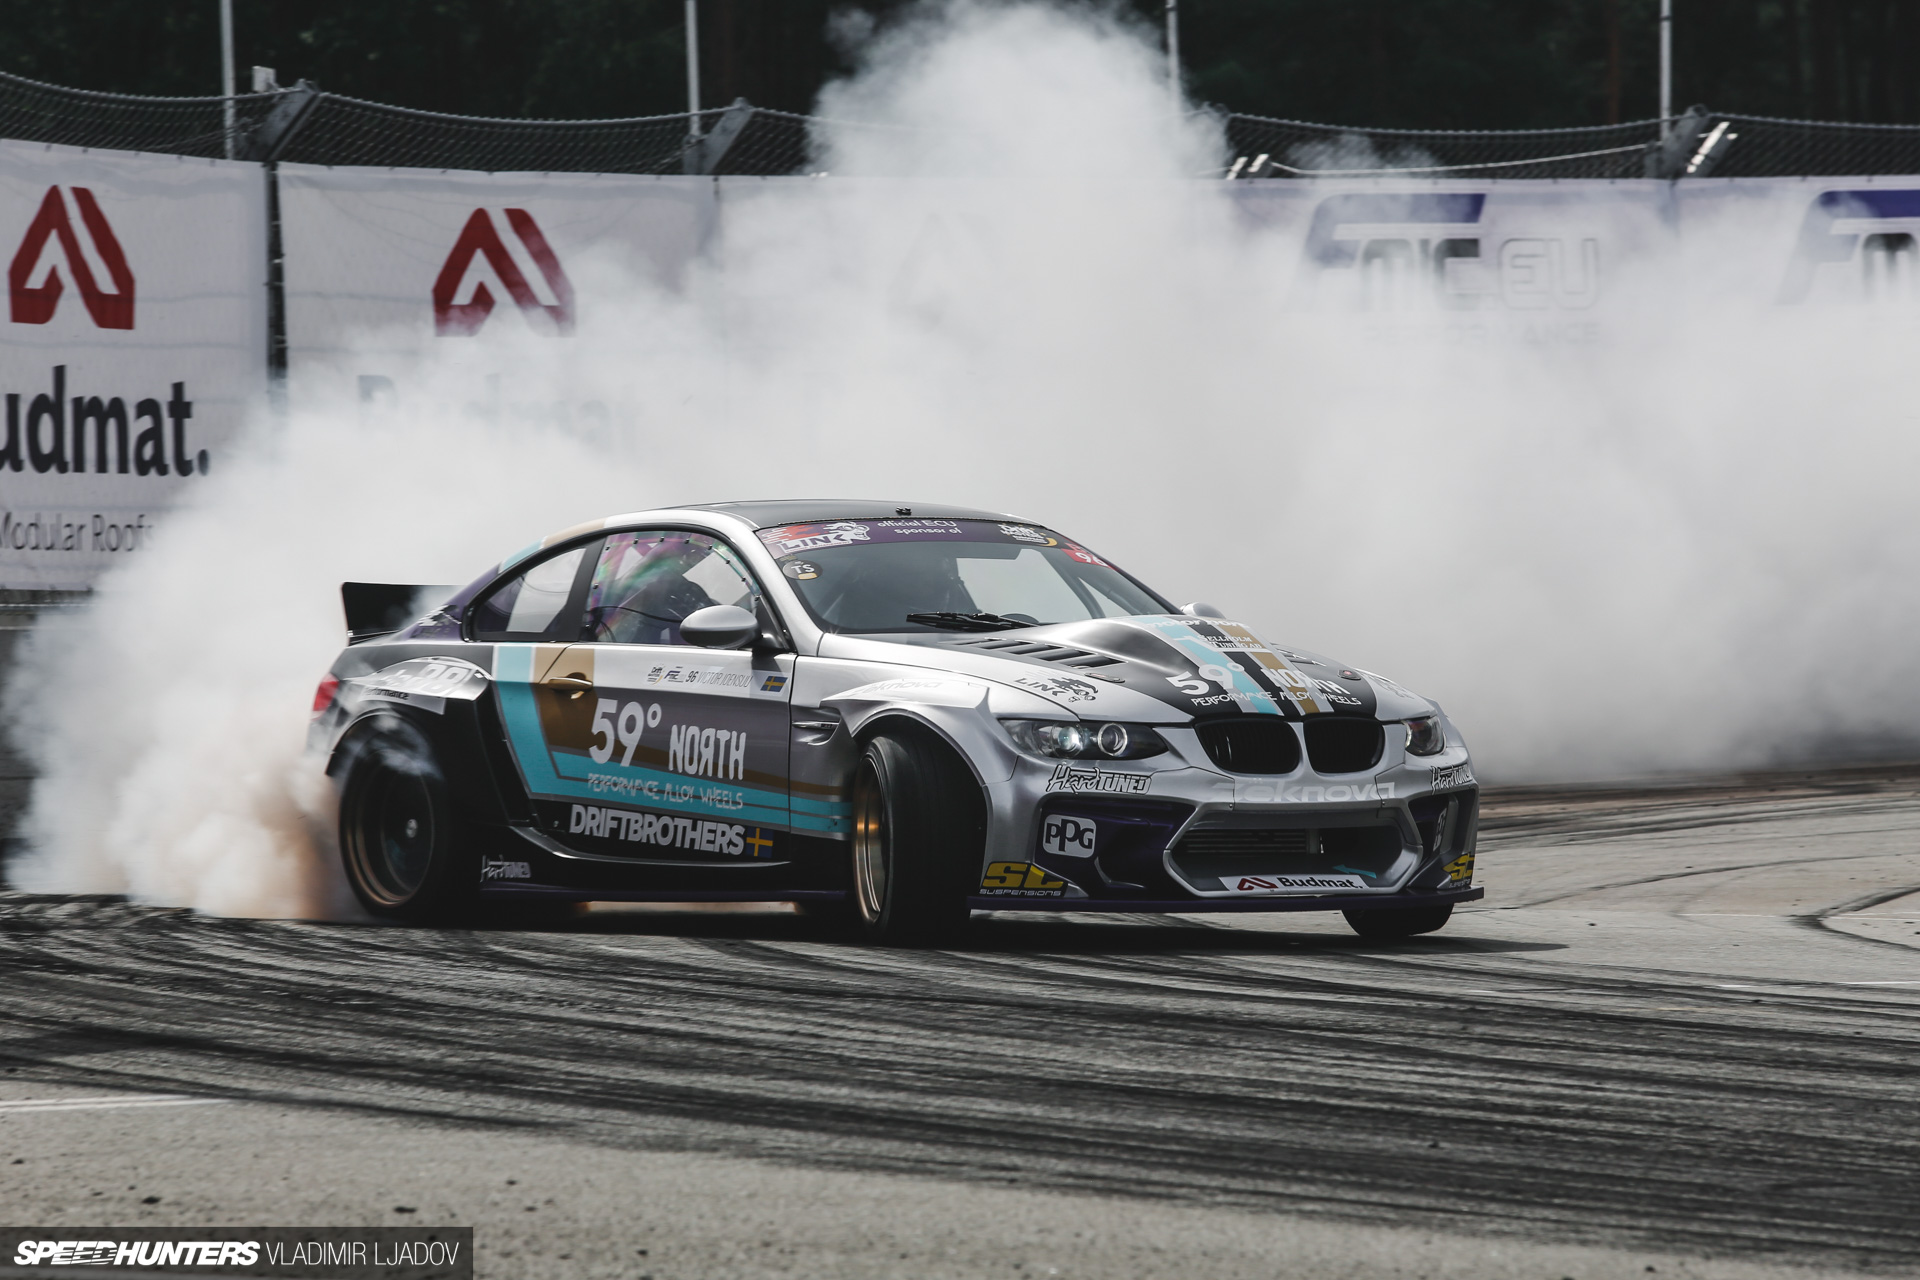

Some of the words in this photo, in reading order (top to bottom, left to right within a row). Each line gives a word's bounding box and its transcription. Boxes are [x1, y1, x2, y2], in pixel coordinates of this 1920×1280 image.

[92, 513, 154, 552] Roof
[781, 534, 848, 551] LINK
[791, 564, 815, 574] TS
[685, 670, 699, 682] 96
[698, 671, 723, 686] VICTOR
[1014, 677, 1067, 697] LINK
[587, 773, 660, 801] PERFORMANCE
[663, 783, 695, 803] ALLOY
[700, 786, 743, 810] WHEELS
[569, 804, 746, 856] DRIFTBROTHERS
[979, 888, 1062, 897] SUSPENSIONS
